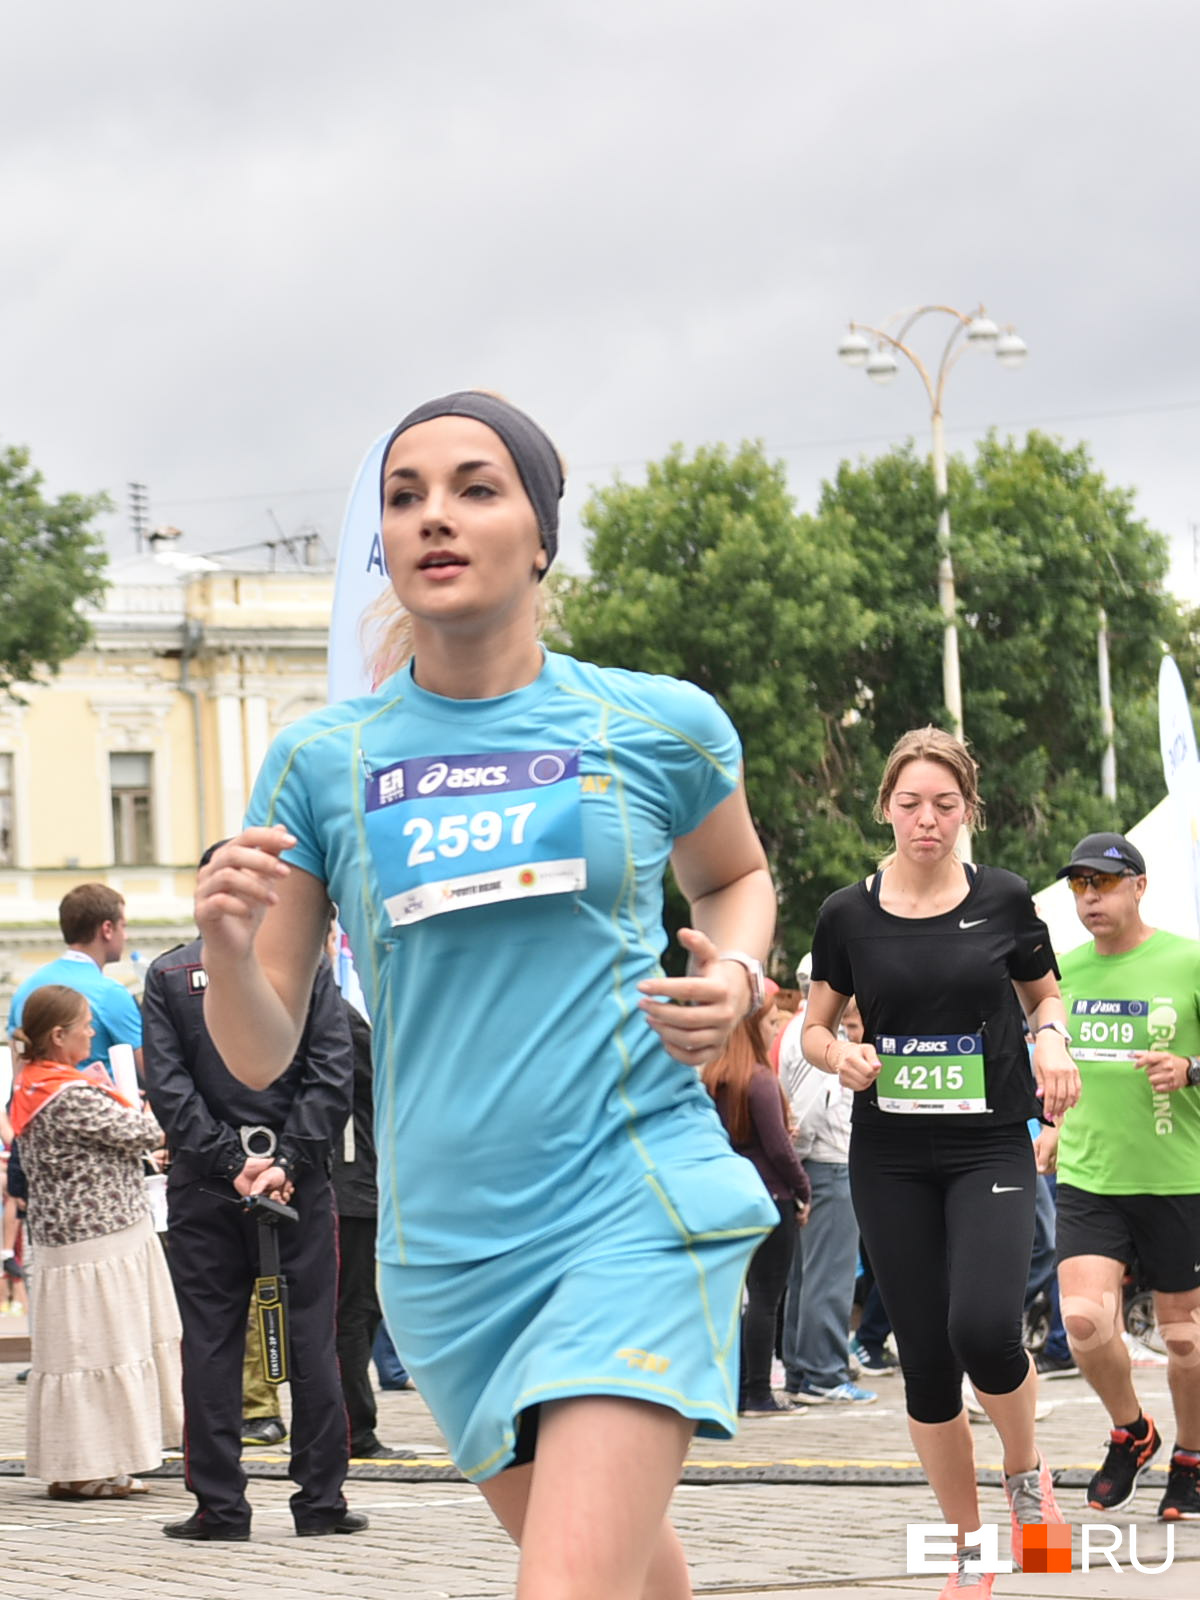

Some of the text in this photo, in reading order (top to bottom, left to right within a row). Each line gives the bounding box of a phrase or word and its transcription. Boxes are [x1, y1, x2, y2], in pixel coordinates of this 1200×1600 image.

[446, 765, 507, 788] asics
[402, 802, 537, 867] 2597
[1080, 1021, 1134, 1043] 5019
[894, 1065, 963, 1090] 4215
